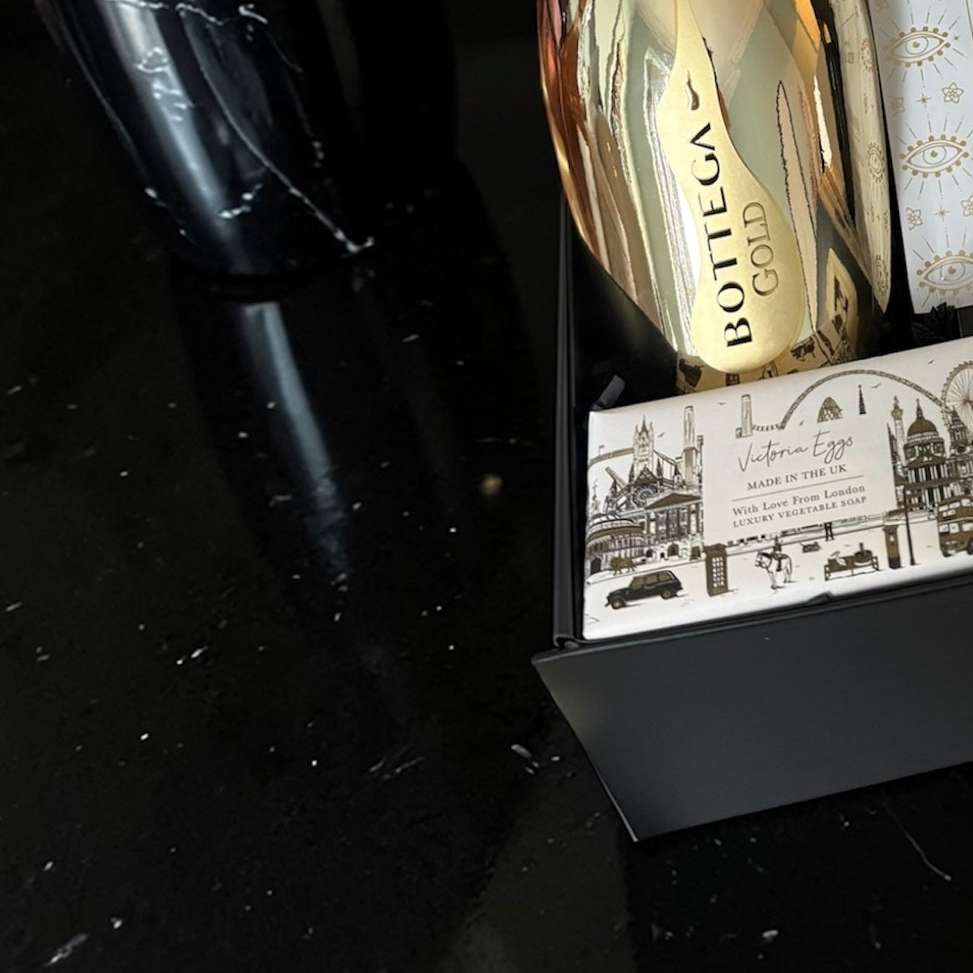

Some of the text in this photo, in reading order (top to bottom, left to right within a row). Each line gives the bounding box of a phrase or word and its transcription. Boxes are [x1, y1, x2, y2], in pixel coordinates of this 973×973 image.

[689, 121, 753, 348] BOTTEGA
[742, 201, 780, 297] GOLD
[738, 429, 854, 473] Victoria Eggs
[747, 464, 848, 491] MADE IN THE UK
[732, 485, 866, 517] With Love From London
[733, 496, 868, 528] LUXURY VEGETABLE SOAP
